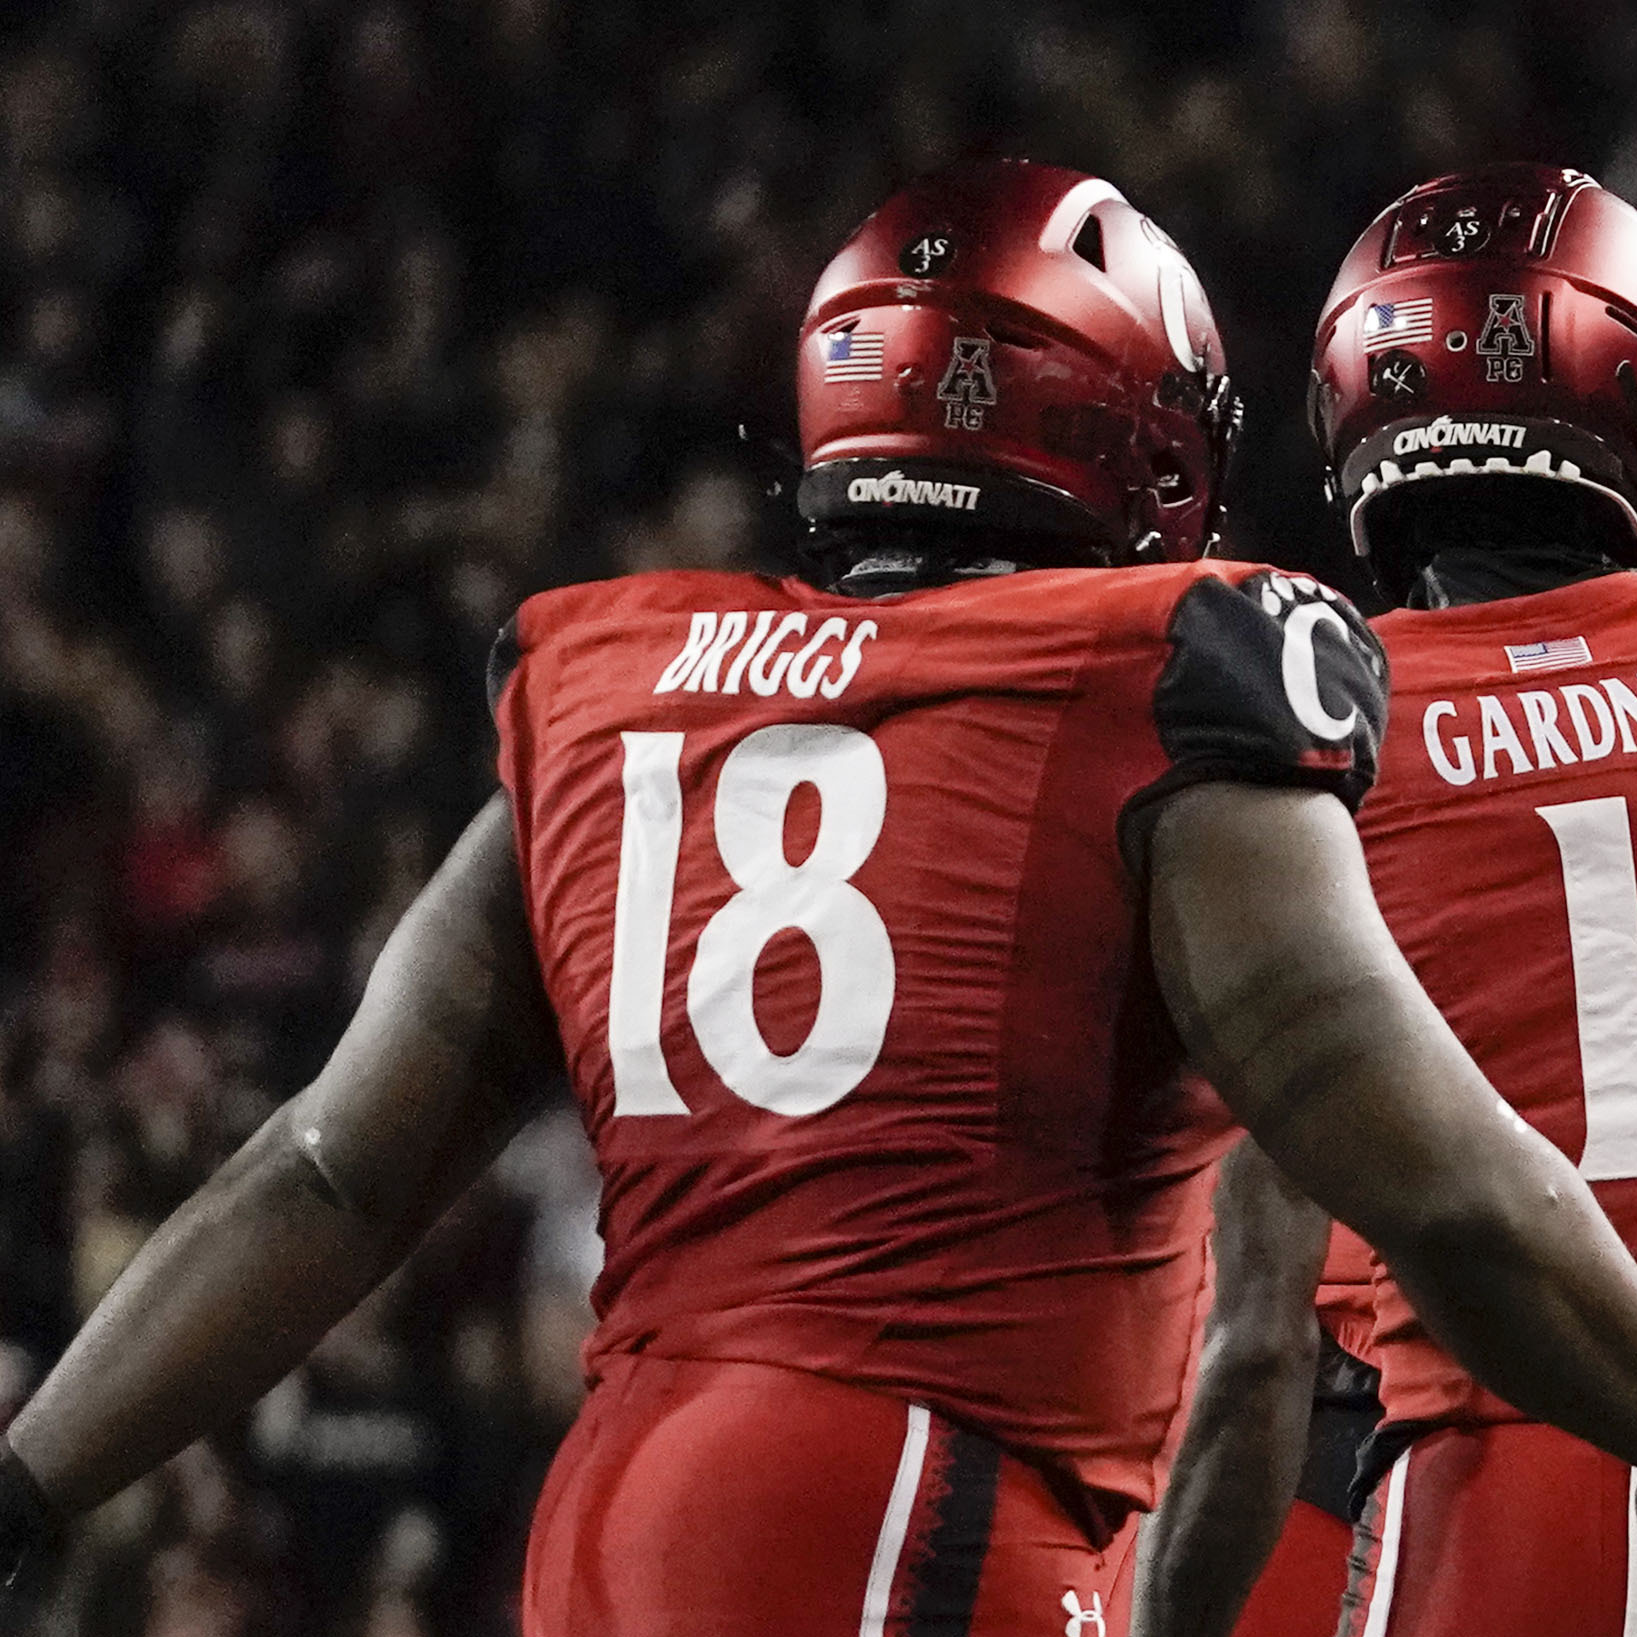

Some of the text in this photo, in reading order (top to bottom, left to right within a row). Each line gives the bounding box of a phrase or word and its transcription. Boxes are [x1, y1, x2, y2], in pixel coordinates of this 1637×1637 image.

[1446, 220, 1480, 237] AS
[1451, 236, 1465, 251] 3
[912, 237, 948, 257] AS
[915, 256, 931, 273] 3
[1393, 415, 1526, 455] CINCINNATI
[848, 470, 981, 510] CINCINNATI
[653, 610, 878, 700] BRIGGS
[608, 723, 895, 1117] 18
